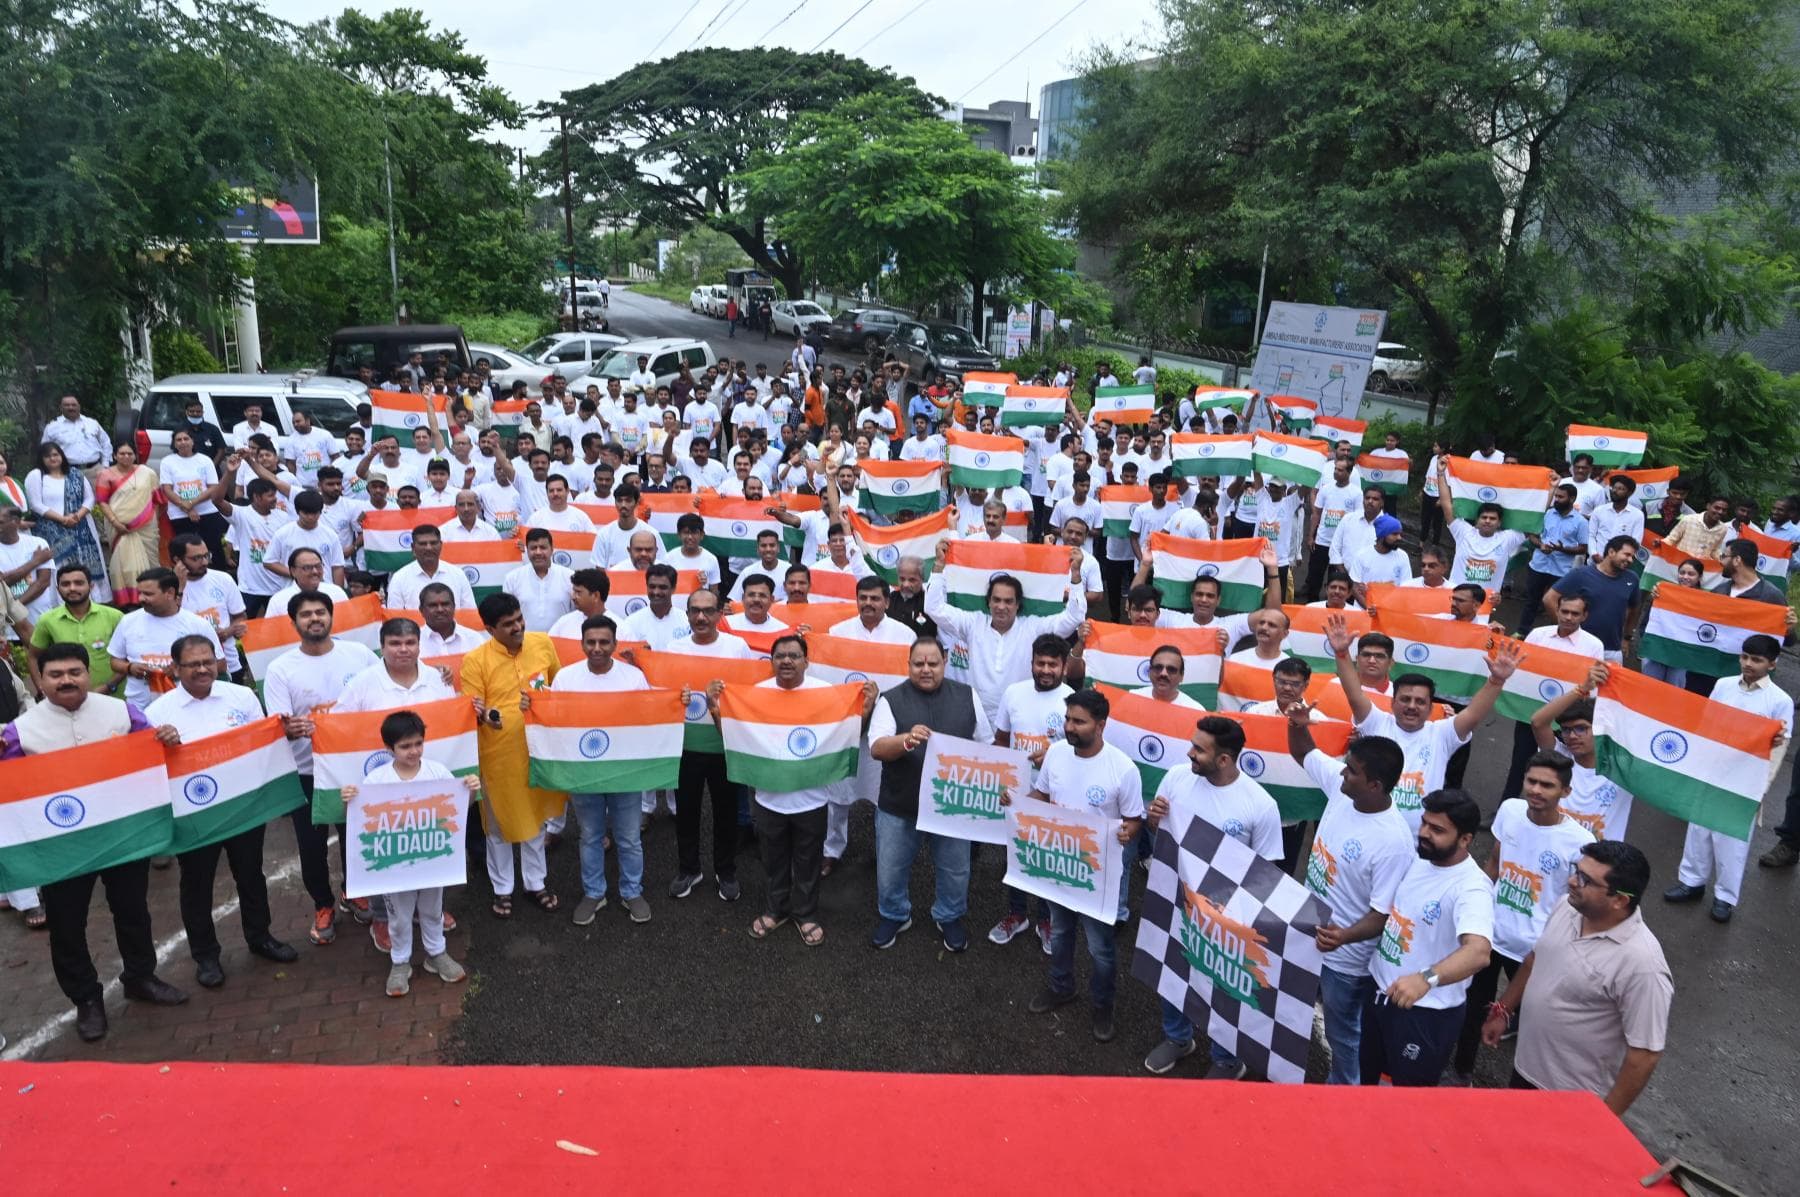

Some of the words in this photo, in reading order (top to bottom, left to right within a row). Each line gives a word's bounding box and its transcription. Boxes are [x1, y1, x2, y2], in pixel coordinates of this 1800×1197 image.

[1343, 341, 1372, 353] ASSOCIATION
[1017, 738, 1043, 753] AZADI
[947, 763, 1001, 794] AZADI
[942, 784, 959, 805] KI
[1393, 790, 1419, 806] DAUD
[376, 807, 437, 835] AZADI
[373, 835, 392, 858] KI
[397, 830, 446, 856] DAUD
[1028, 824, 1081, 858] AZADI
[1025, 846, 1040, 867] KI
[1045, 852, 1089, 883] DAUD
[1502, 868, 1531, 890] AZADI
[1190, 903, 1246, 966] AZADI
[1188, 925, 1201, 958] KI
[1203, 943, 1253, 998] DAUD
